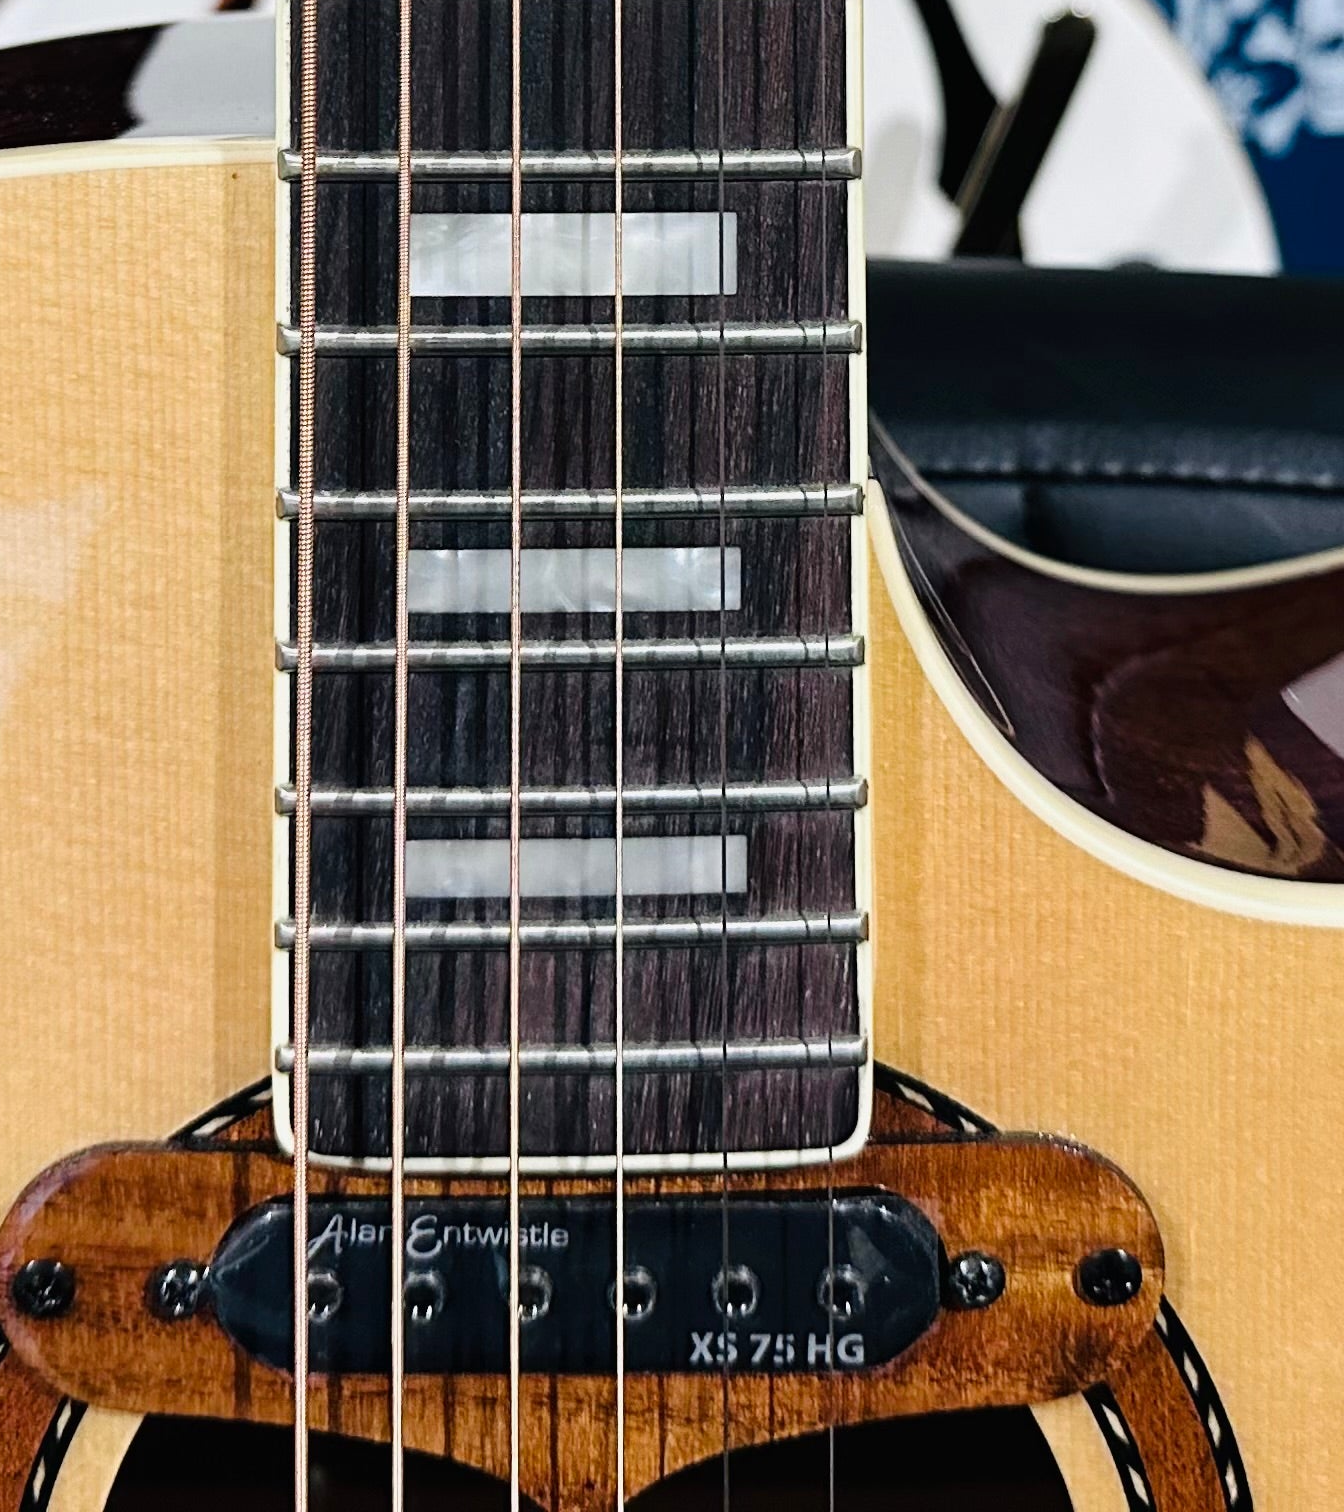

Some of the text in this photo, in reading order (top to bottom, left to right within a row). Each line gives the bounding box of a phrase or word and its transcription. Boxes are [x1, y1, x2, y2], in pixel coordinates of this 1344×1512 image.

[689, 1331, 865, 1365] XS 75 HG
